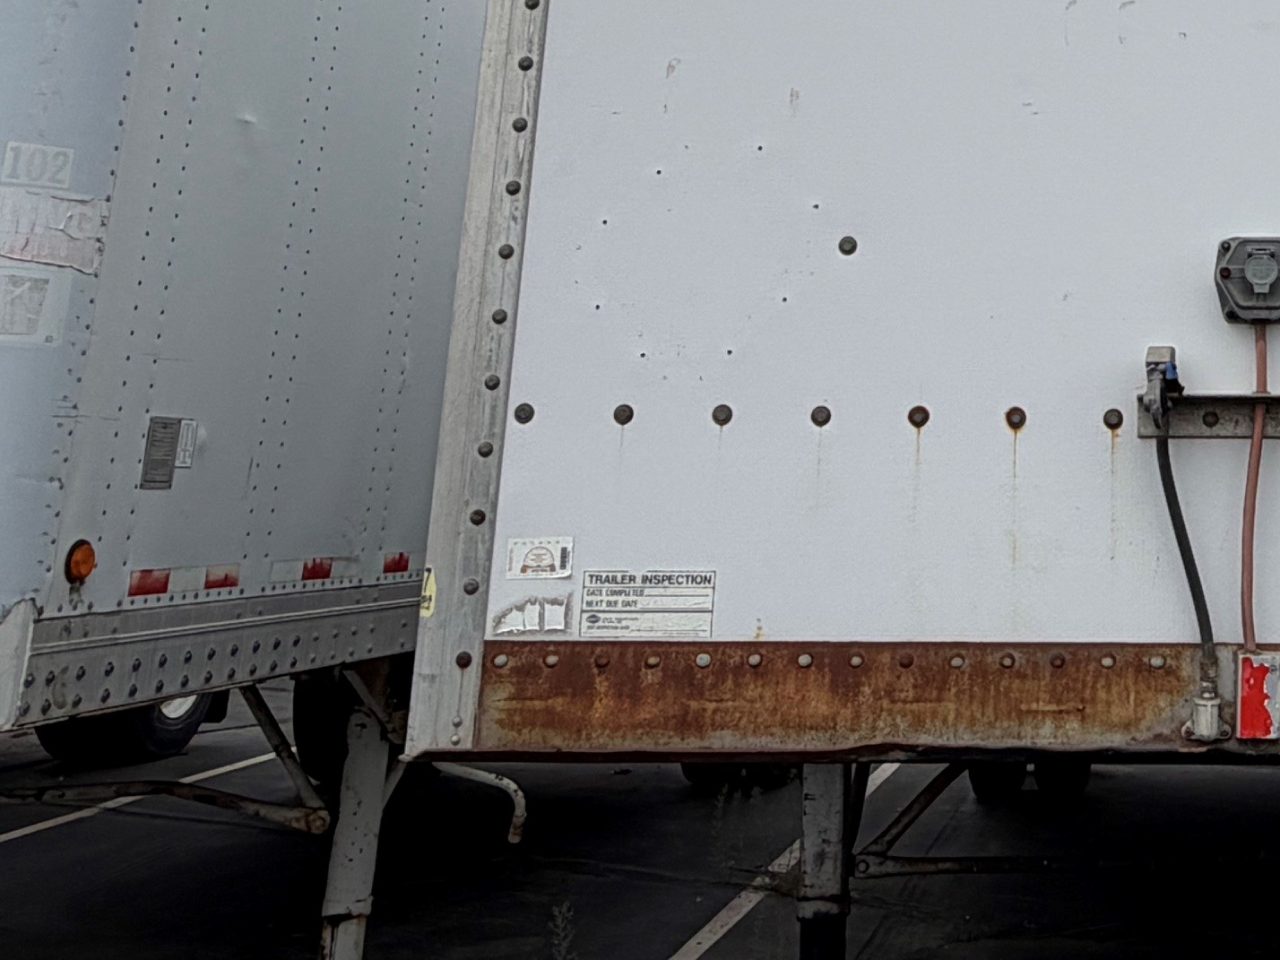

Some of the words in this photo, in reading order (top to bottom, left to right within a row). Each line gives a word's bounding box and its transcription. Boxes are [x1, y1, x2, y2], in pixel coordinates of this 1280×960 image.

[4, 145, 70, 185] 102
[588, 574, 636, 585] TRAILER
[640, 574, 712, 585] INSPECTION
